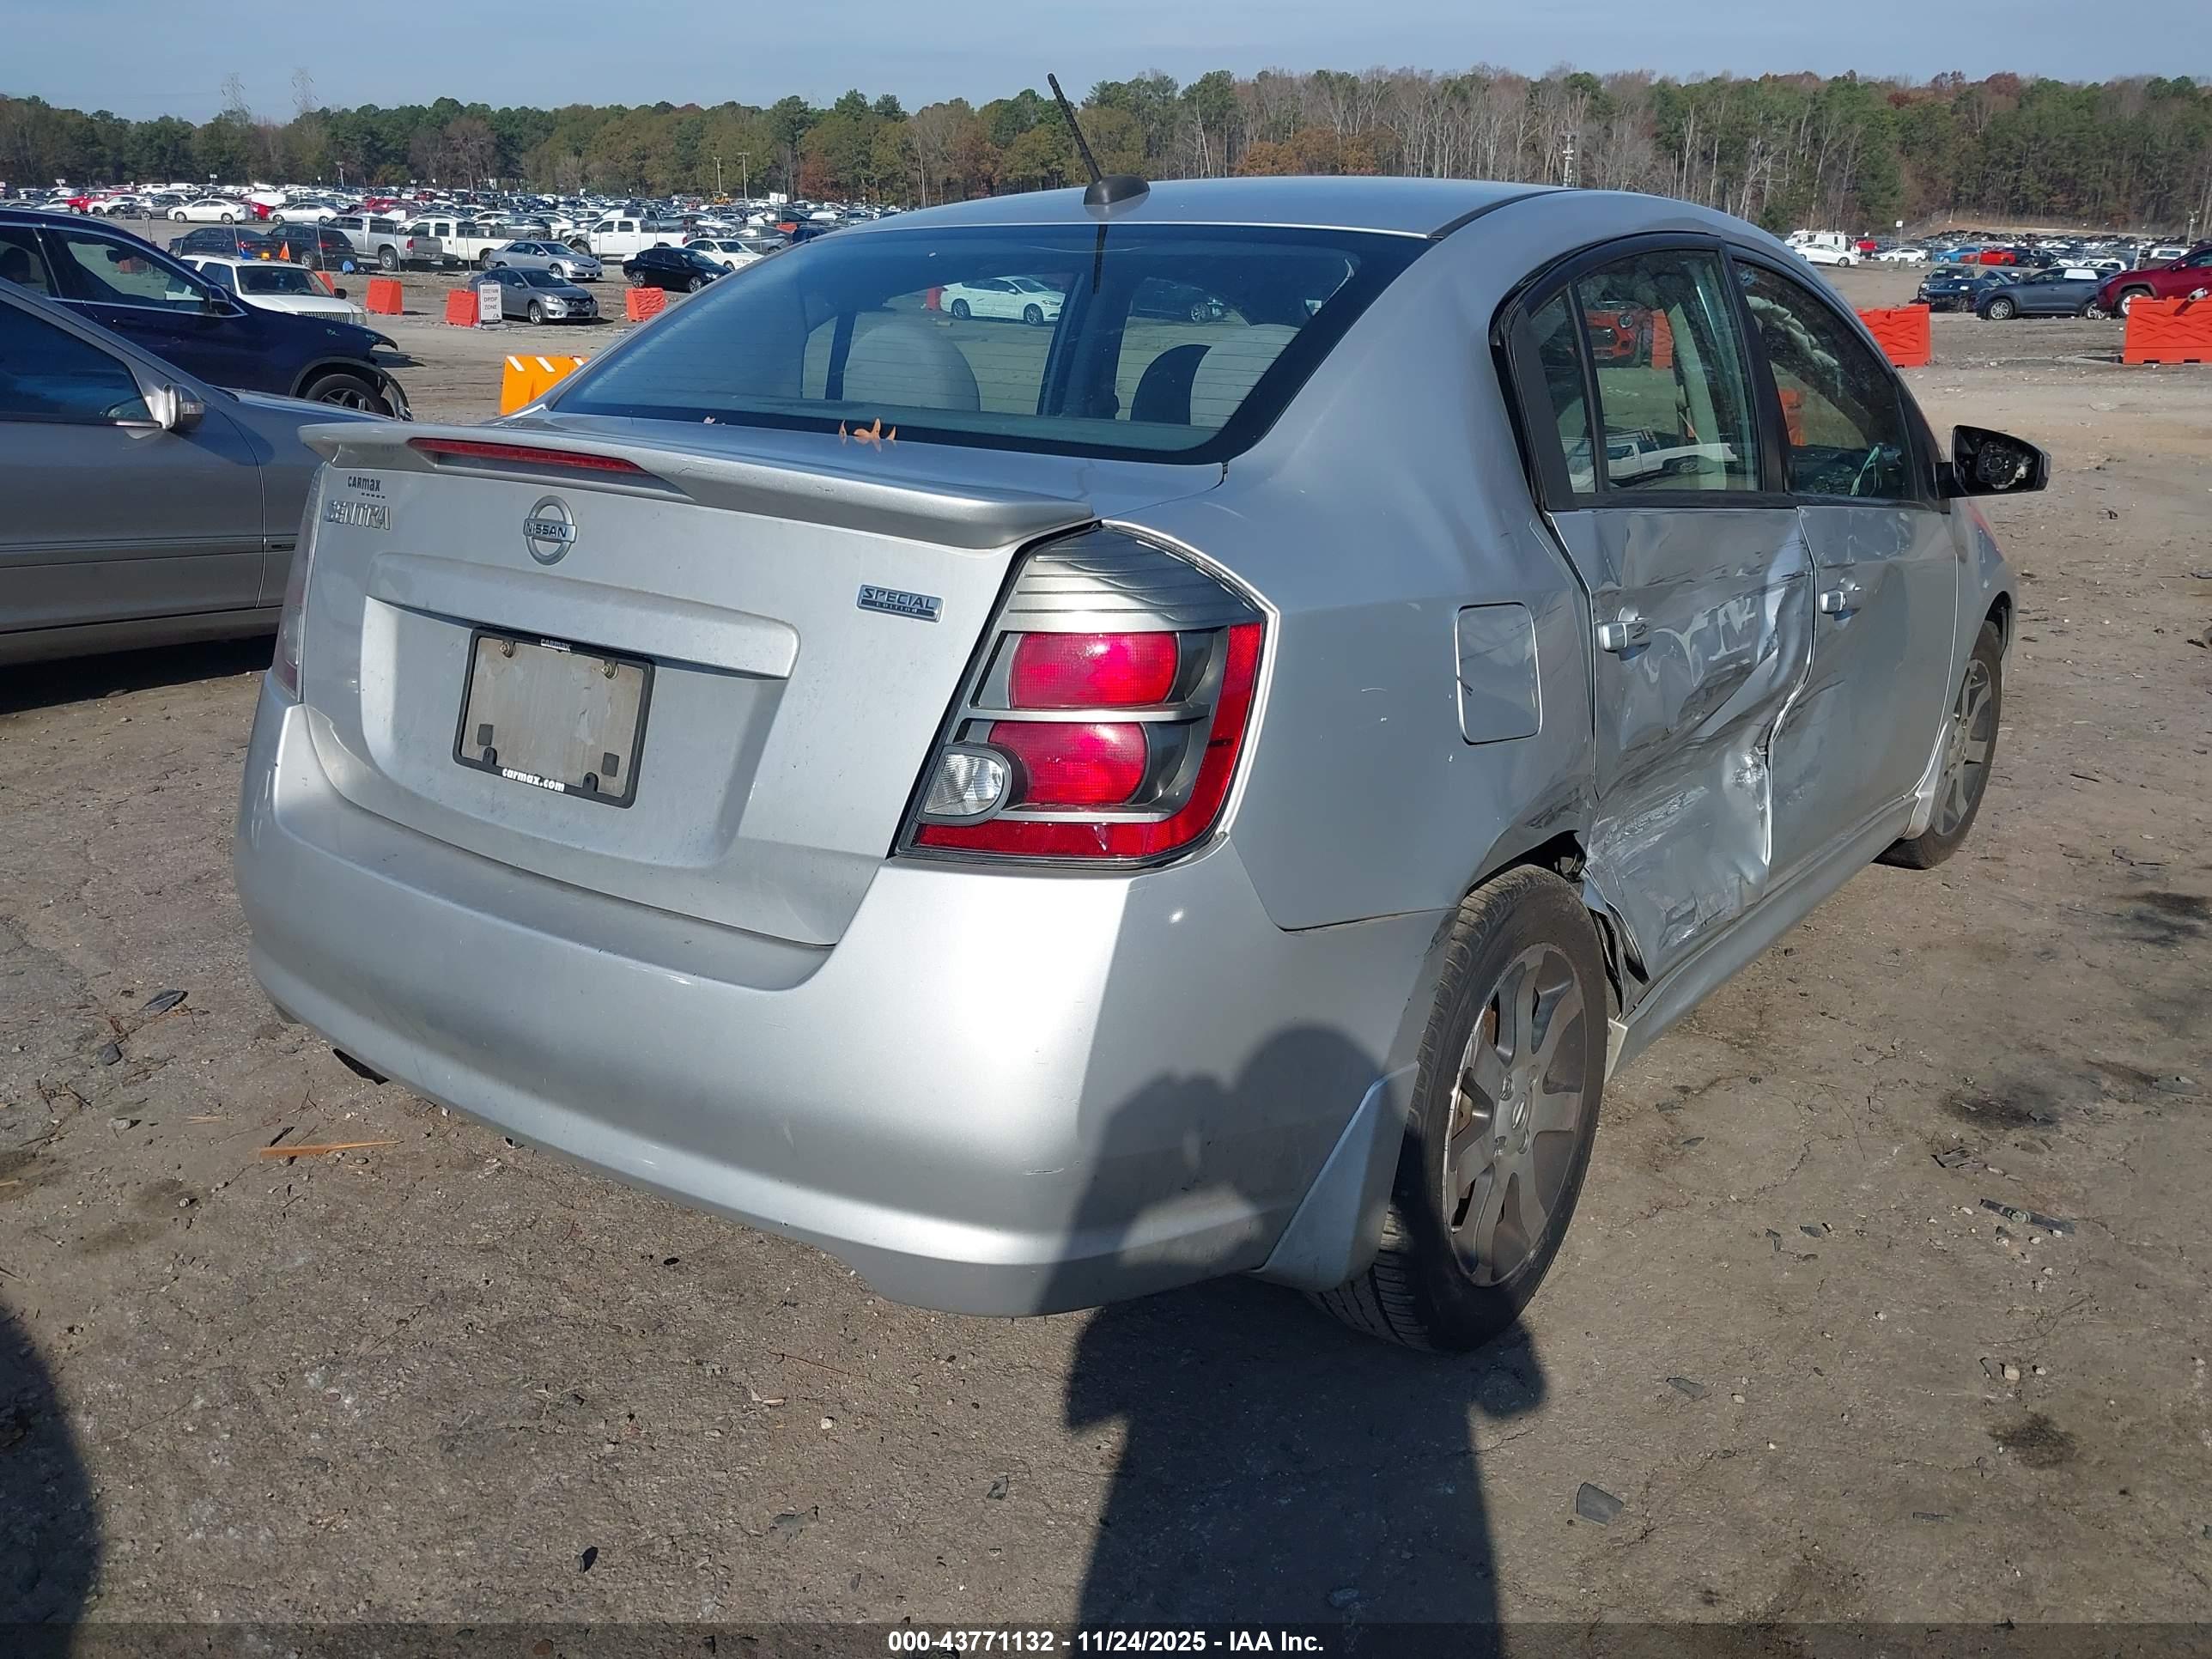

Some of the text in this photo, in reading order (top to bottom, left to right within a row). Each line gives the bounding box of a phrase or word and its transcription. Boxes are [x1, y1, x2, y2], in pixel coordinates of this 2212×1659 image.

[324, 500, 391, 530] SENTRA
[526, 521, 568, 538] NISSAN
[862, 587, 935, 610] SPECIAL
[501, 768, 566, 793] carmax.com
